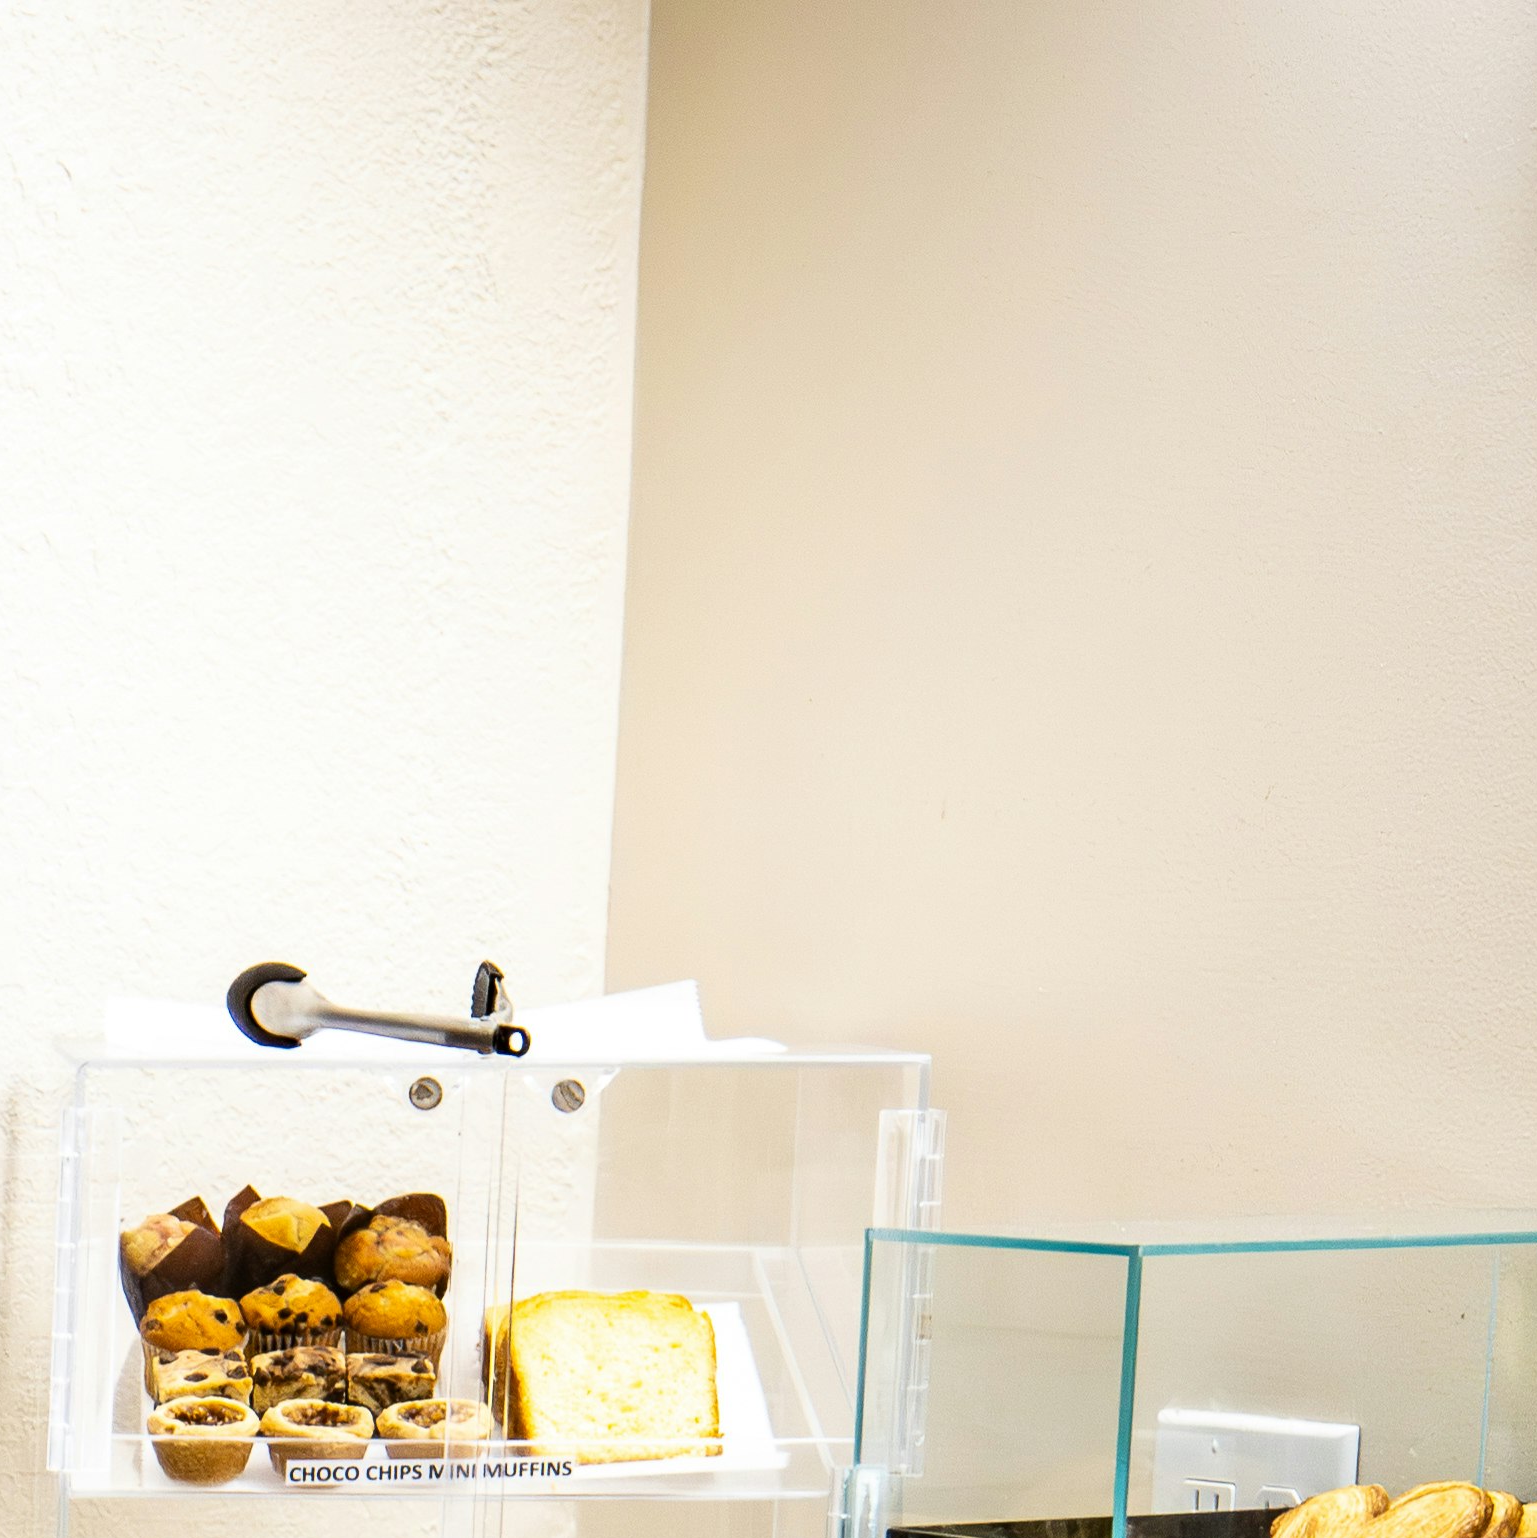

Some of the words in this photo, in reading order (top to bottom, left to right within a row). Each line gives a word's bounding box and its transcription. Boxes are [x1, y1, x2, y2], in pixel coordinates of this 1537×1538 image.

[288, 1465, 360, 1483] CHOCO
[366, 1463, 423, 1481] CHIPS
[482, 1460, 573, 1478] MUFFINS
